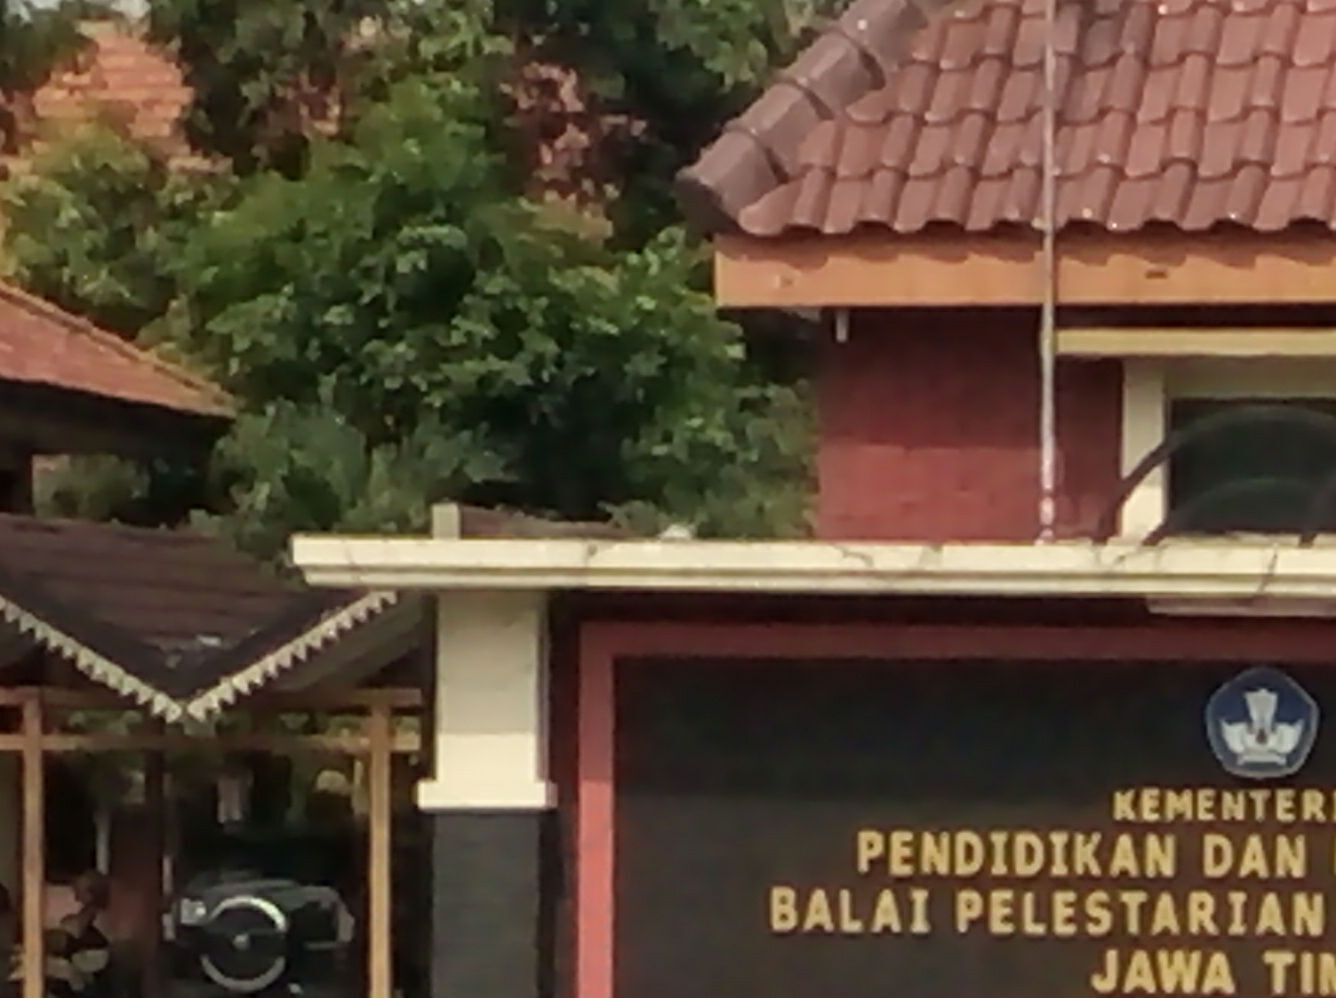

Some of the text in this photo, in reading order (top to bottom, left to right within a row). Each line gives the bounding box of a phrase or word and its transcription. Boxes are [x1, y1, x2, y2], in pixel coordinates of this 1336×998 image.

[858, 830, 1176, 878] PENDIDIKAN
[1203, 834, 1306, 879] DAN
[769, 886, 930, 934] BALAI
[955, 890, 1324, 937] PELESTARIAN
[1091, 949, 1235, 995] JAWA
